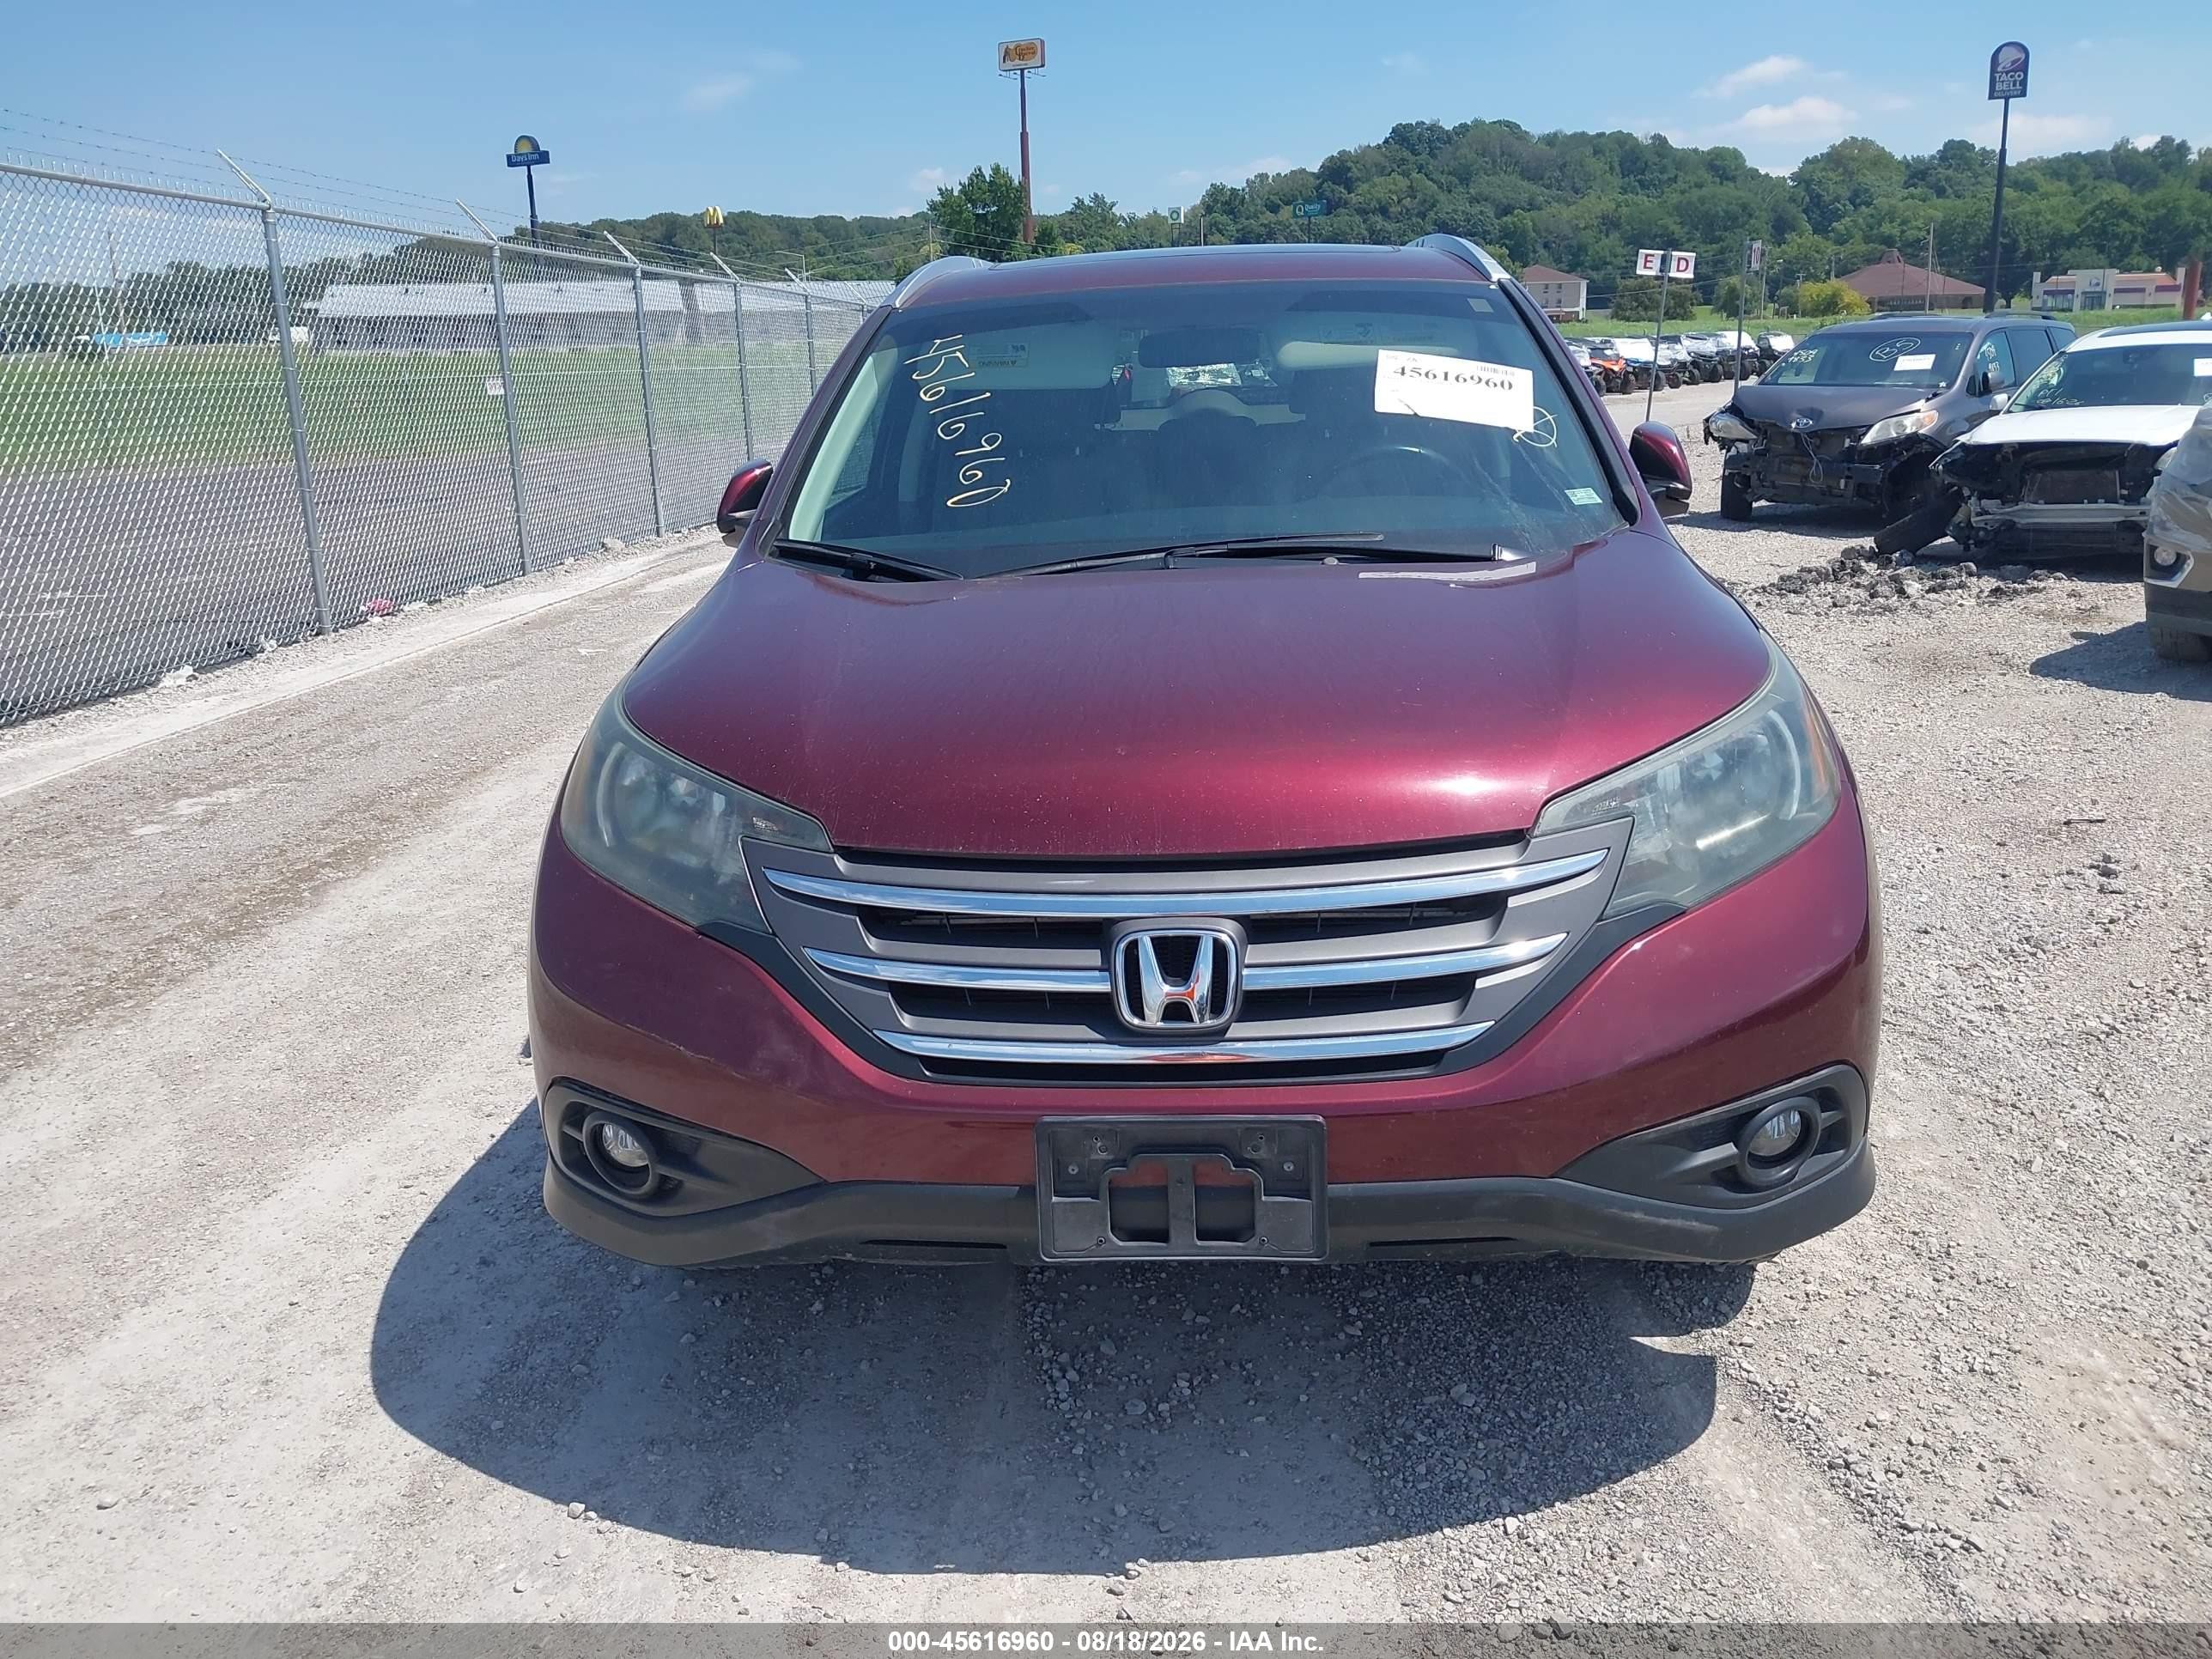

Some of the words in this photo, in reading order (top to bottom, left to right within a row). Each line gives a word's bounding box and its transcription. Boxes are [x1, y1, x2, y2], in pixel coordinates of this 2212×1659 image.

[1995, 71, 2024, 82] TACO
[1996, 81, 2023, 91] BELL
[1643, 253, 1656, 270] E
[1676, 257, 1689, 273] D
[1393, 365, 1514, 391] 45616960
[903, 334, 1011, 507] 45616960
